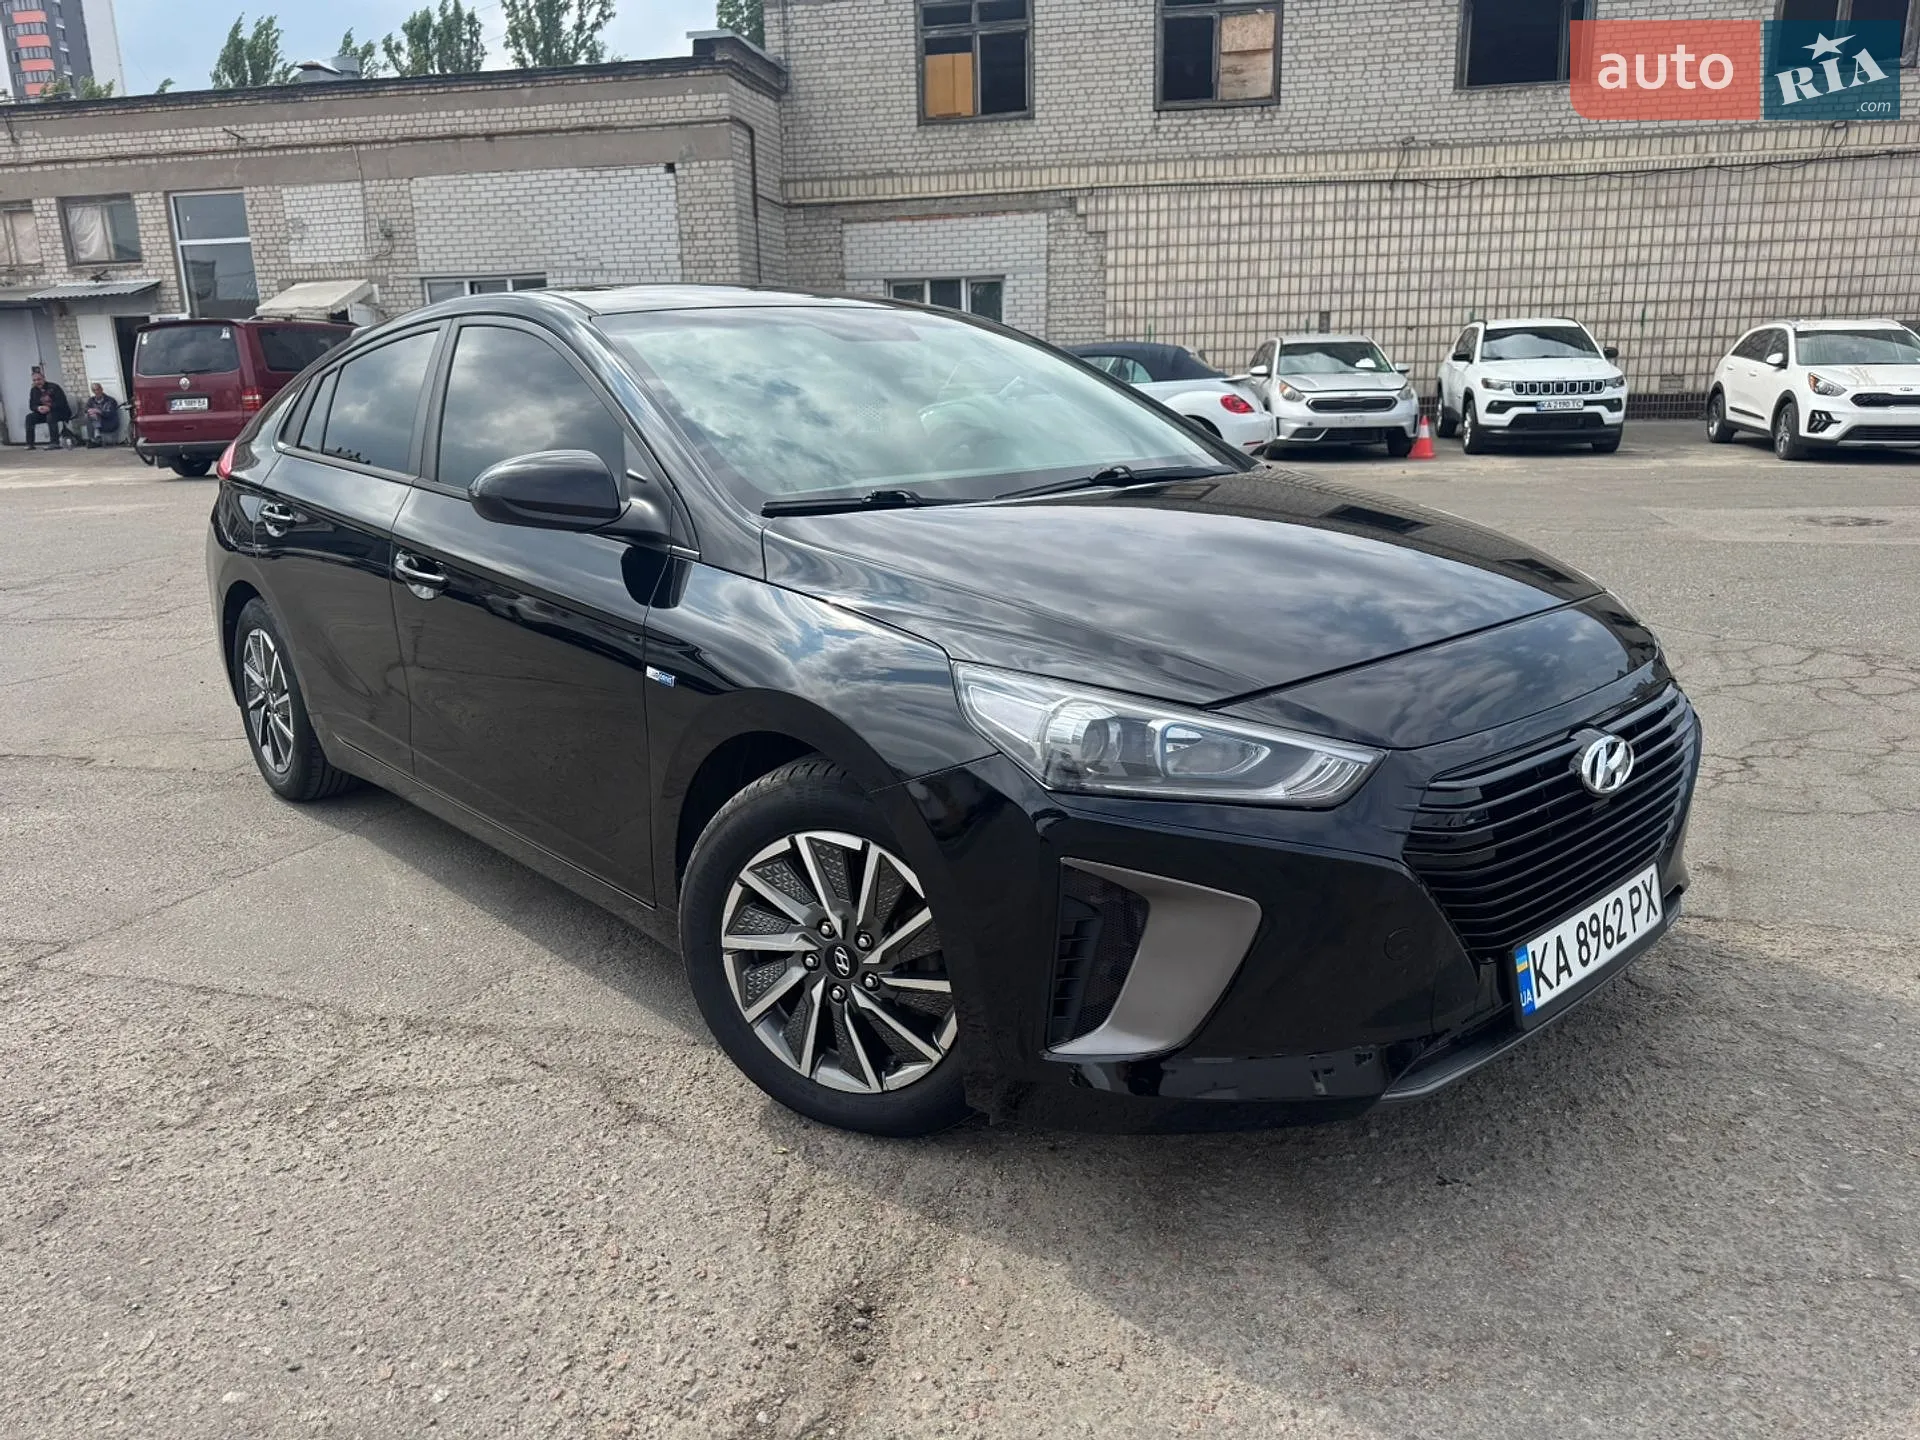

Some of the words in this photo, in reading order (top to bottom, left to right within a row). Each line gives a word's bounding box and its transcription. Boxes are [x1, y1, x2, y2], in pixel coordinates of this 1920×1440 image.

[1531, 935, 1573, 998] KA
[1576, 897, 1627, 968] 8962
[1628, 873, 1659, 934] PX
[1520, 989, 1534, 1007] UA
